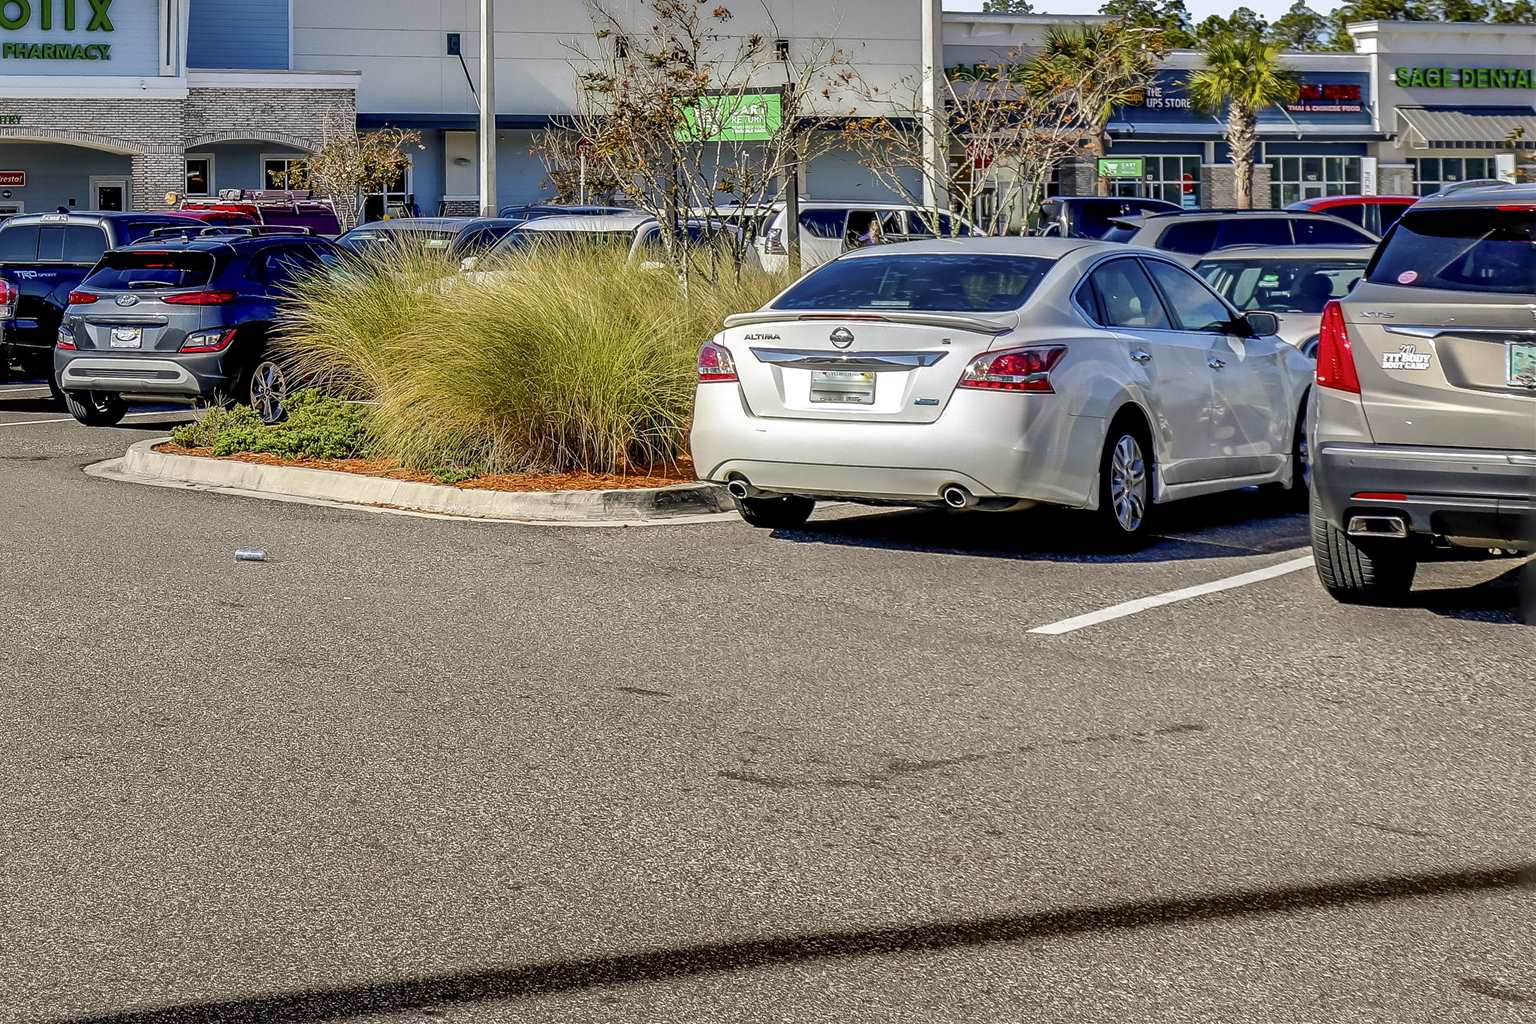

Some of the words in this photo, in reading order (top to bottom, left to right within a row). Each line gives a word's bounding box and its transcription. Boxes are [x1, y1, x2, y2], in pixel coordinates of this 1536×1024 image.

[2, 43, 111, 60] PHARMACY
[1395, 66, 1452, 88] SAGE
[1147, 87, 1163, 97] THE
[1146, 97, 1163, 108] UPS
[1165, 98, 1191, 108] STORE
[13, 270, 37, 280] TRD
[743, 333, 781, 341] ALTIMA
